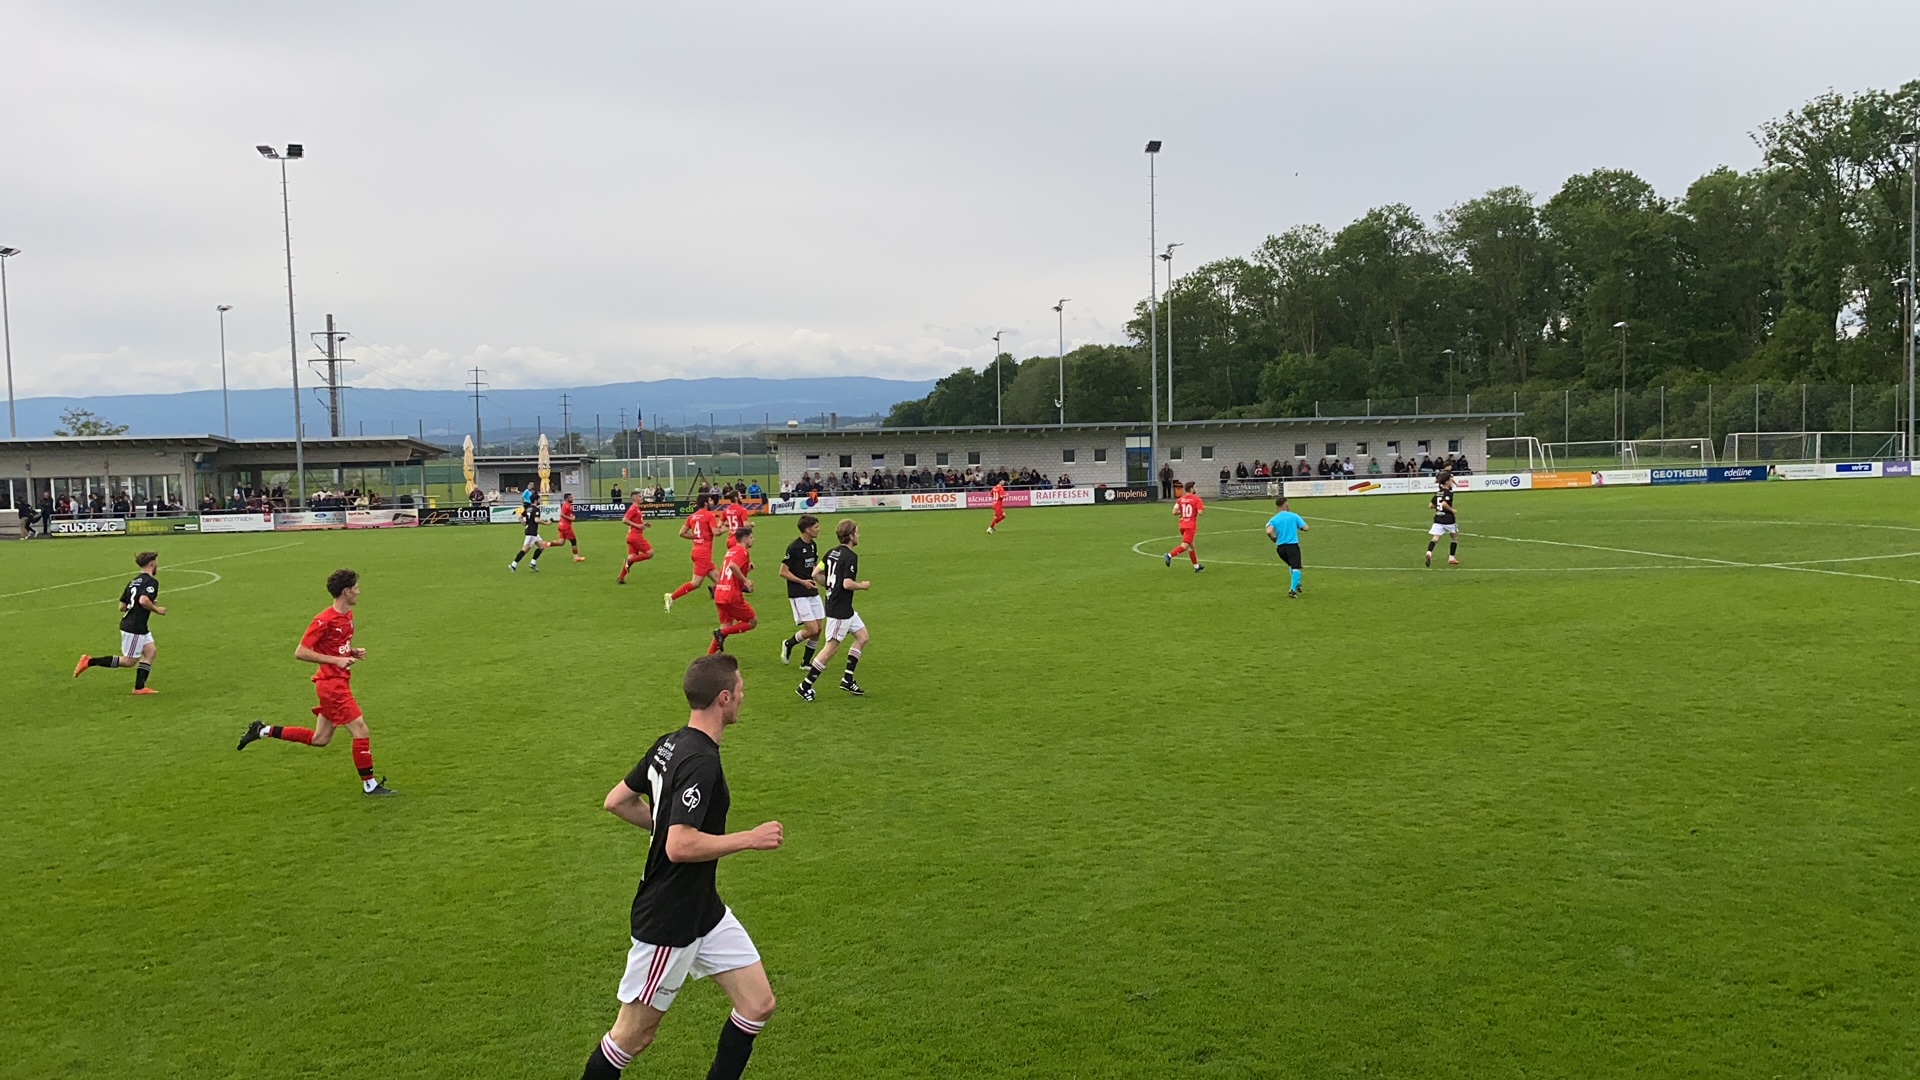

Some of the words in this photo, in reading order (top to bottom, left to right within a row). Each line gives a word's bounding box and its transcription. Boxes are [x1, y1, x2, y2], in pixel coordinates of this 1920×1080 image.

[1653, 469, 1708, 479] GEOTHERM
[1886, 465, 1908, 473] valiant
[1485, 477, 1509, 487] groupe
[911, 493, 957, 504] MIGROS
[1036, 490, 1089, 500] RAIFFEISEN
[1116, 490, 1147, 500] Implenia
[590, 503, 626, 511] FREITAG
[1436, 497, 1443, 511] 5
[457, 508, 488, 519] form
[1181, 503, 1193, 518] 10
[59, 522, 98, 532] STUDER
[100, 522, 118, 531] AG
[727, 515, 739, 530] 15
[693, 520, 702, 538] 4
[720, 559, 733, 580] 14
[126, 586, 137, 609] 3
